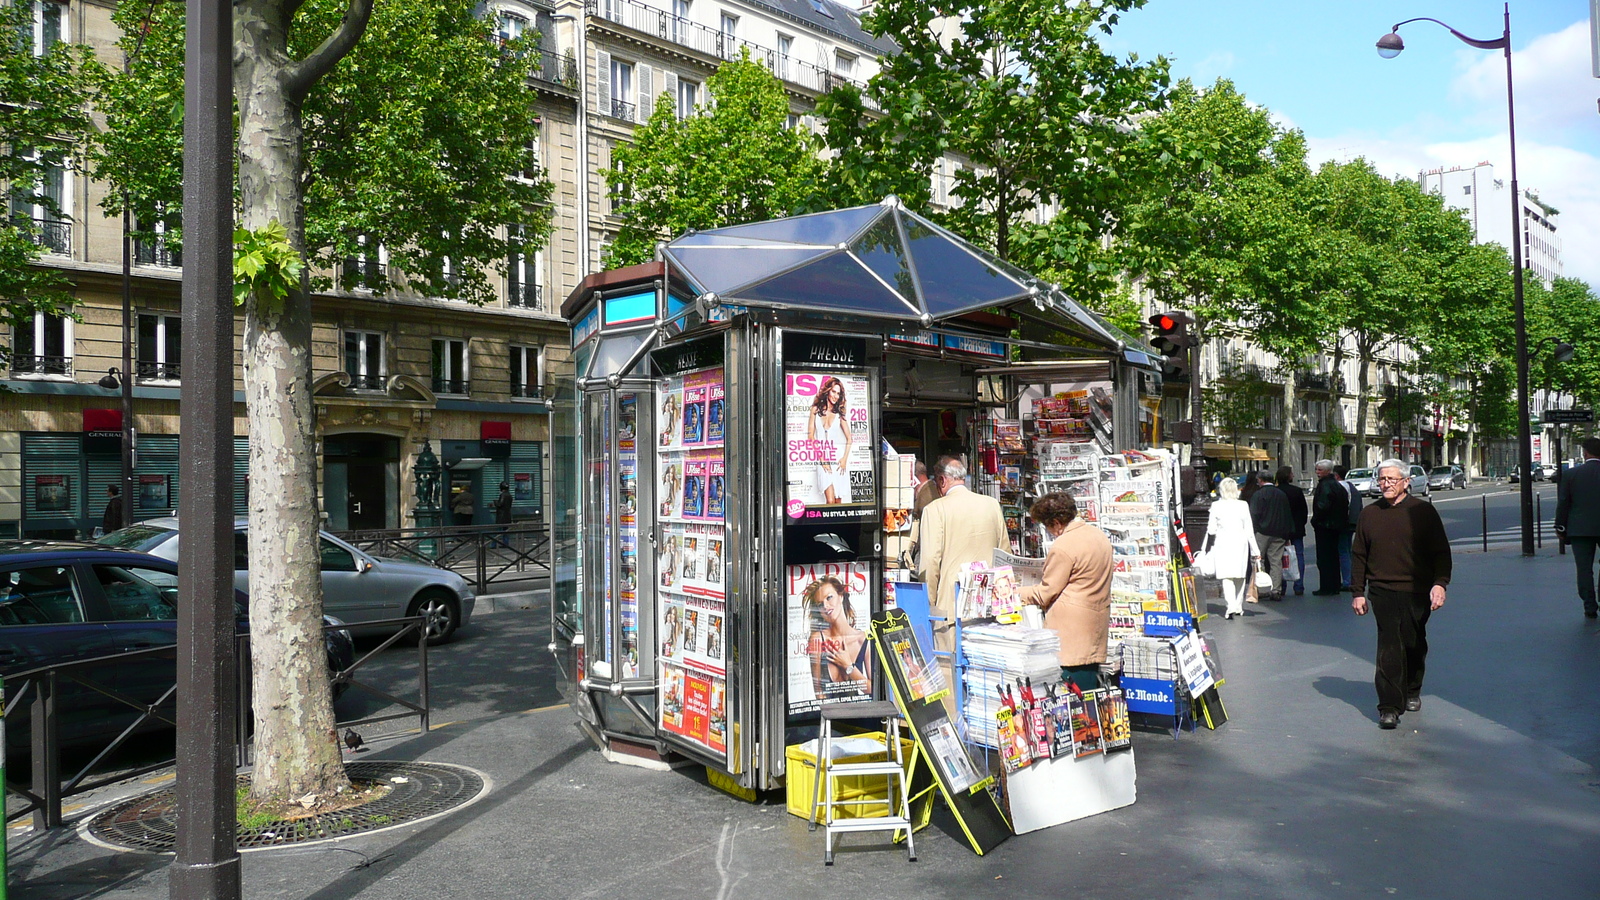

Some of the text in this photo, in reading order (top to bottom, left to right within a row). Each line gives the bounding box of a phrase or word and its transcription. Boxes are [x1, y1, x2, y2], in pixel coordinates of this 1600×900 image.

[809, 343, 855, 362] PRESSE
[850, 408, 868, 421] 218
[850, 421, 868, 430] HITS
[788, 439, 838, 451] SPECIAL
[788, 450, 837, 462] COUPLE
[850, 471, 873, 484] 50%
[806, 510, 822, 518] ISA
[1146, 614, 1156, 625] Le
[1125, 688, 1135, 699] Le
